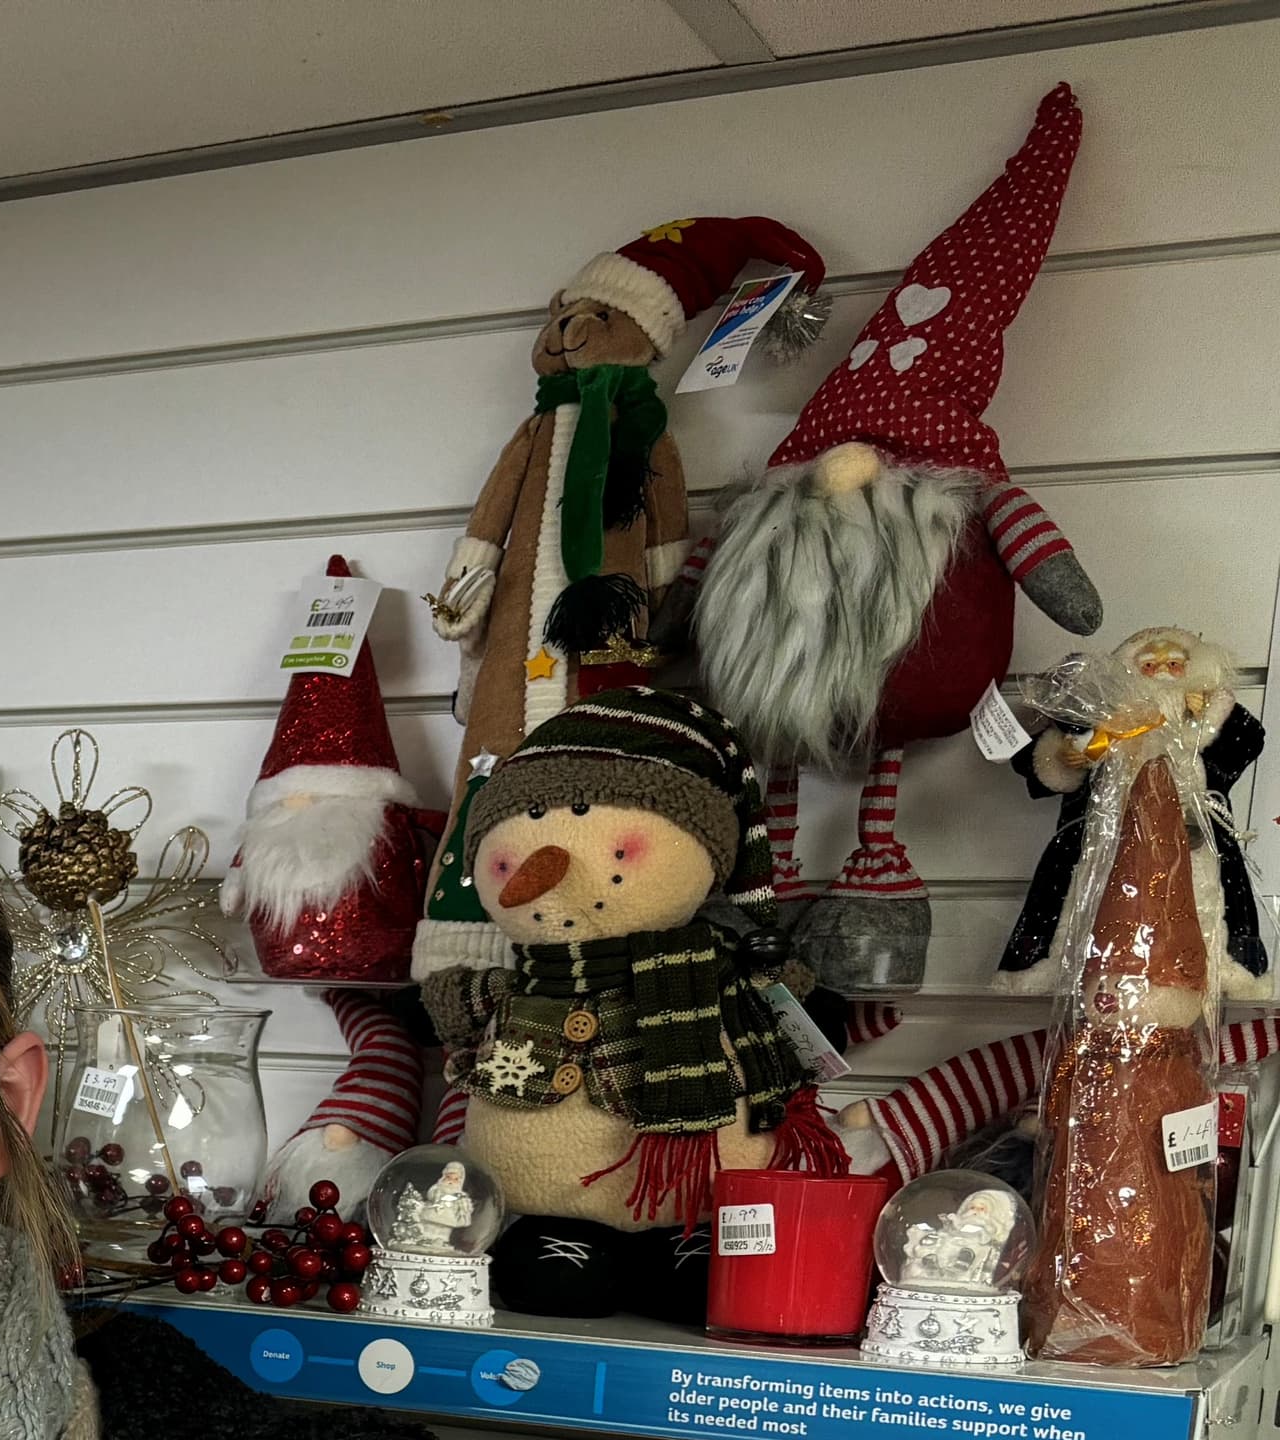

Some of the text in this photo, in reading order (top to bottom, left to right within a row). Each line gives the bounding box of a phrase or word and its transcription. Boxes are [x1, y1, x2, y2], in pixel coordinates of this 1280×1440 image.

[263, 1349, 290, 1360] Donate
[376, 1361, 396, 1371] Shop
[671, 1369, 1071, 1421] By transforming items into actions, we give
[668, 1408, 807, 1435] its needed most
[669, 1390, 714, 1406] older
[719, 1397, 778, 1414] people
[783, 1402, 816, 1416] and
[822, 1404, 866, 1421] their
[871, 1407, 947, 1429] families
[952, 1419, 1028, 1437] support
